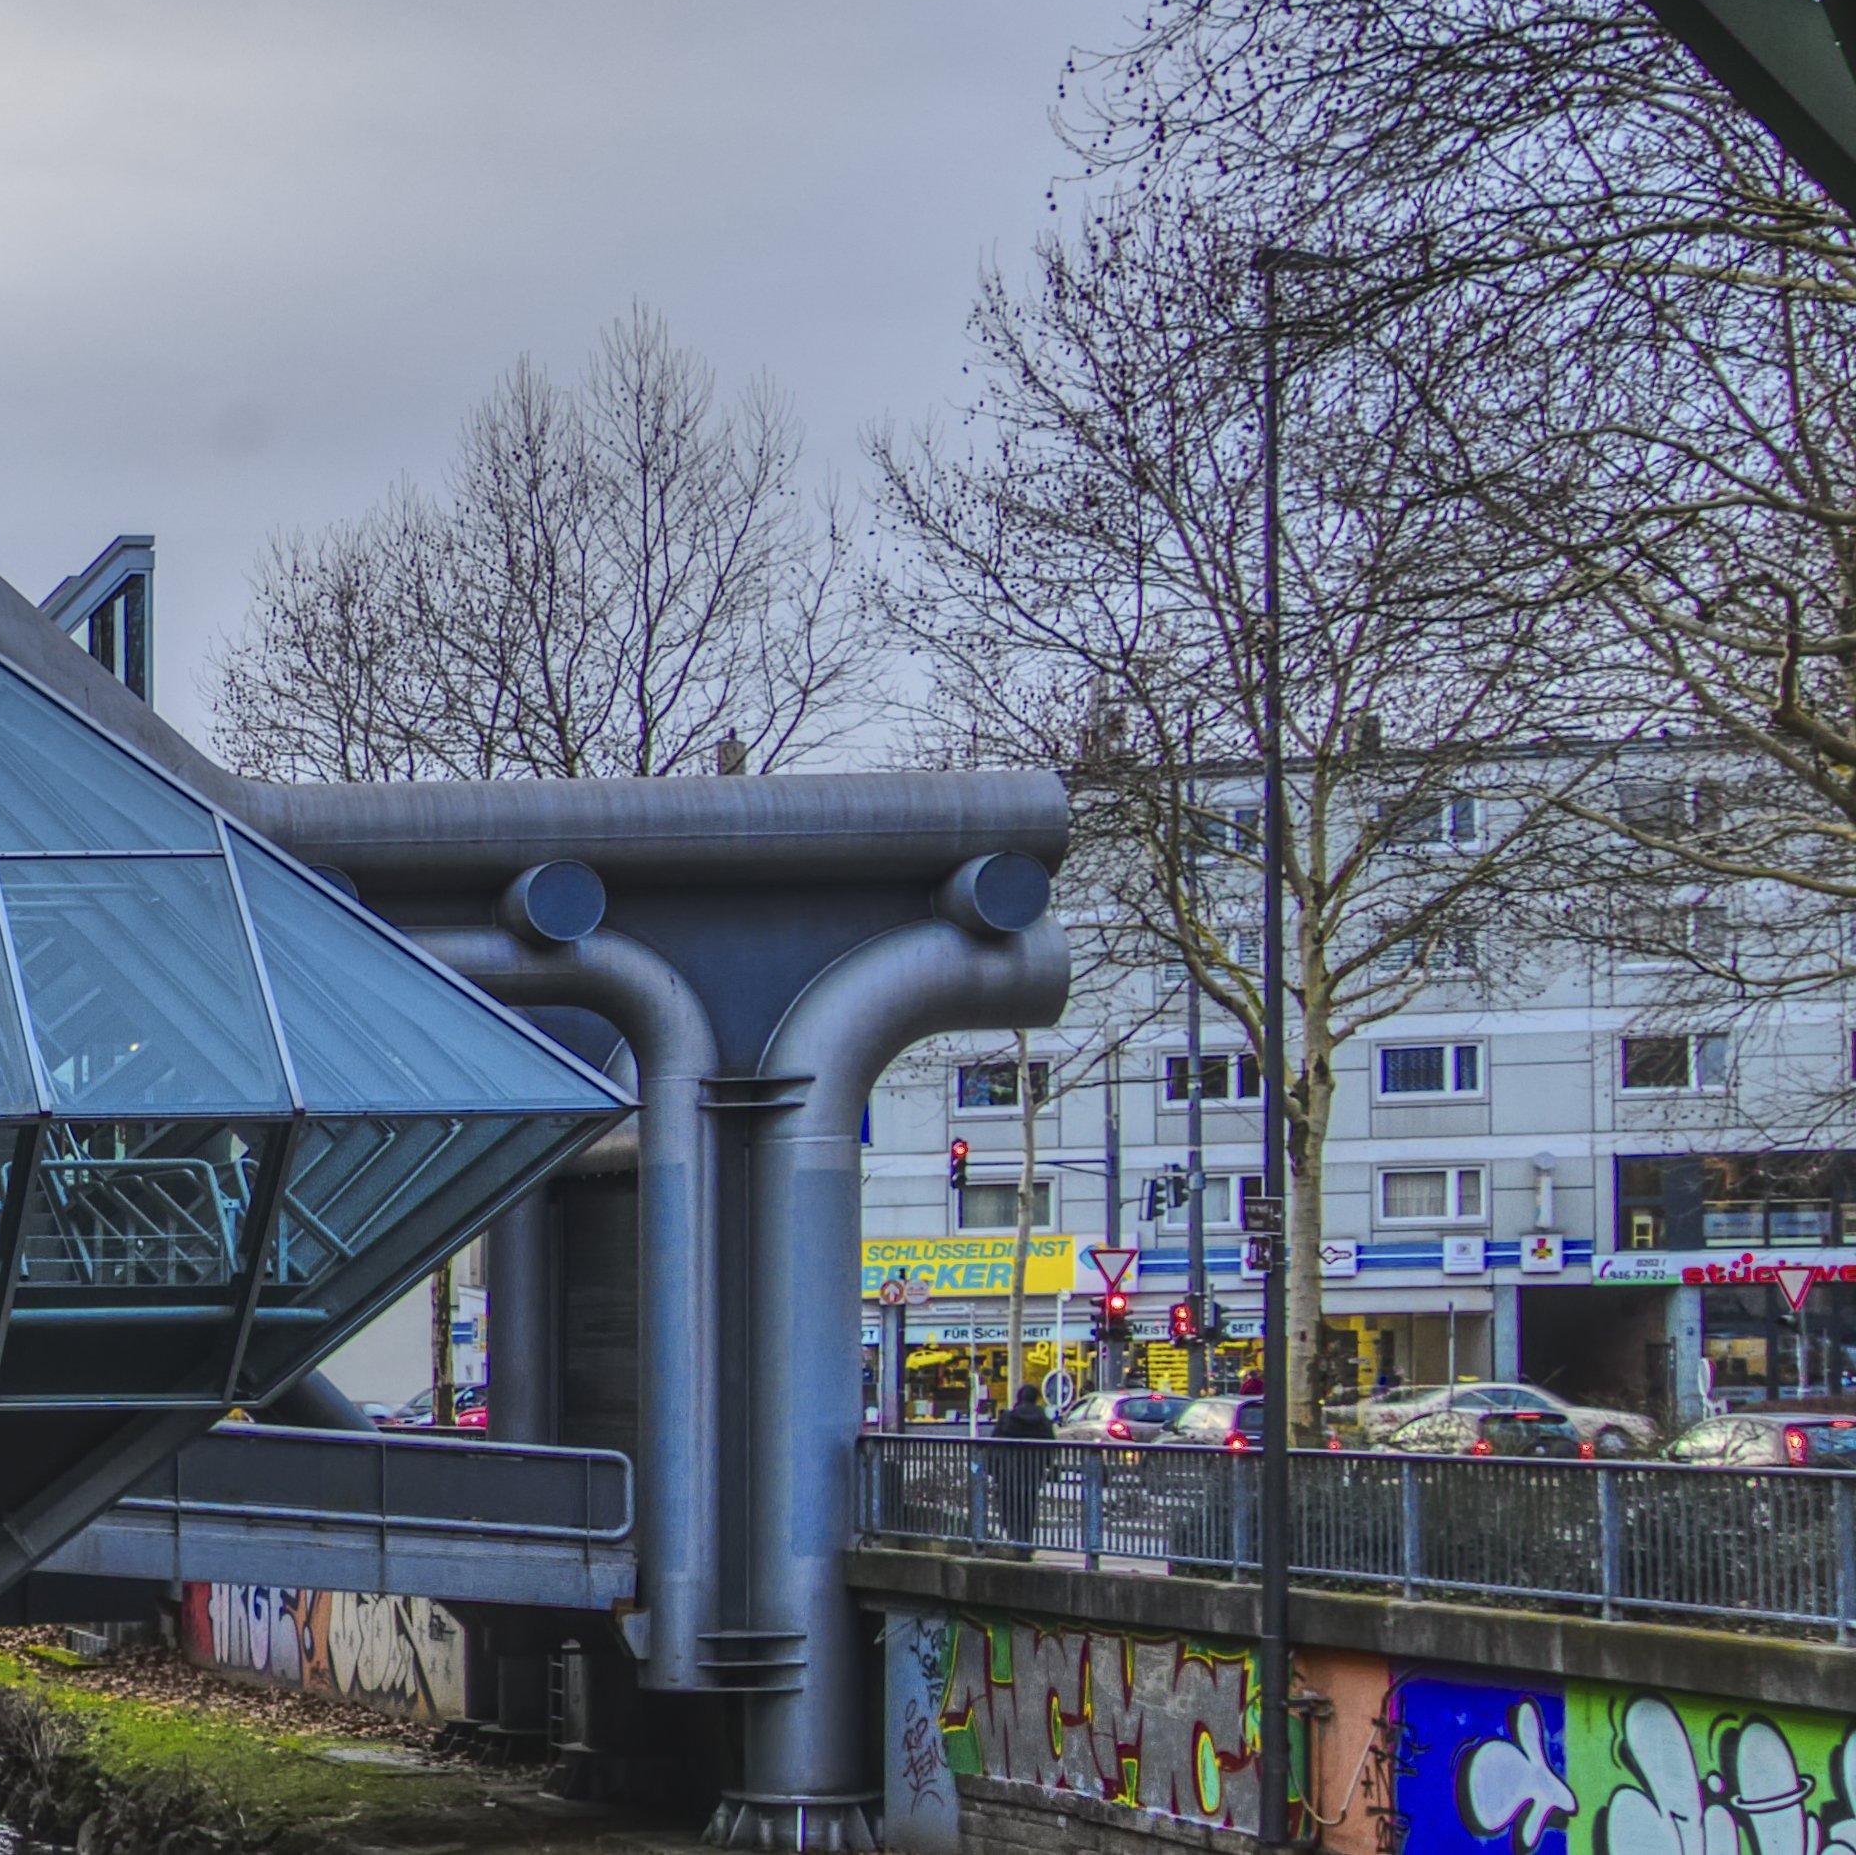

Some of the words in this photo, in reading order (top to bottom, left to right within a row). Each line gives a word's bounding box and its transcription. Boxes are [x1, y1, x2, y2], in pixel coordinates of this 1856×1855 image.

[867, 1238, 1070, 1261] SCHLÜSSELDINST
[863, 1263, 1012, 1291] BECKER
[944, 1327, 969, 1339] FÜR
[974, 1327, 1051, 1339] SICHHEIT
